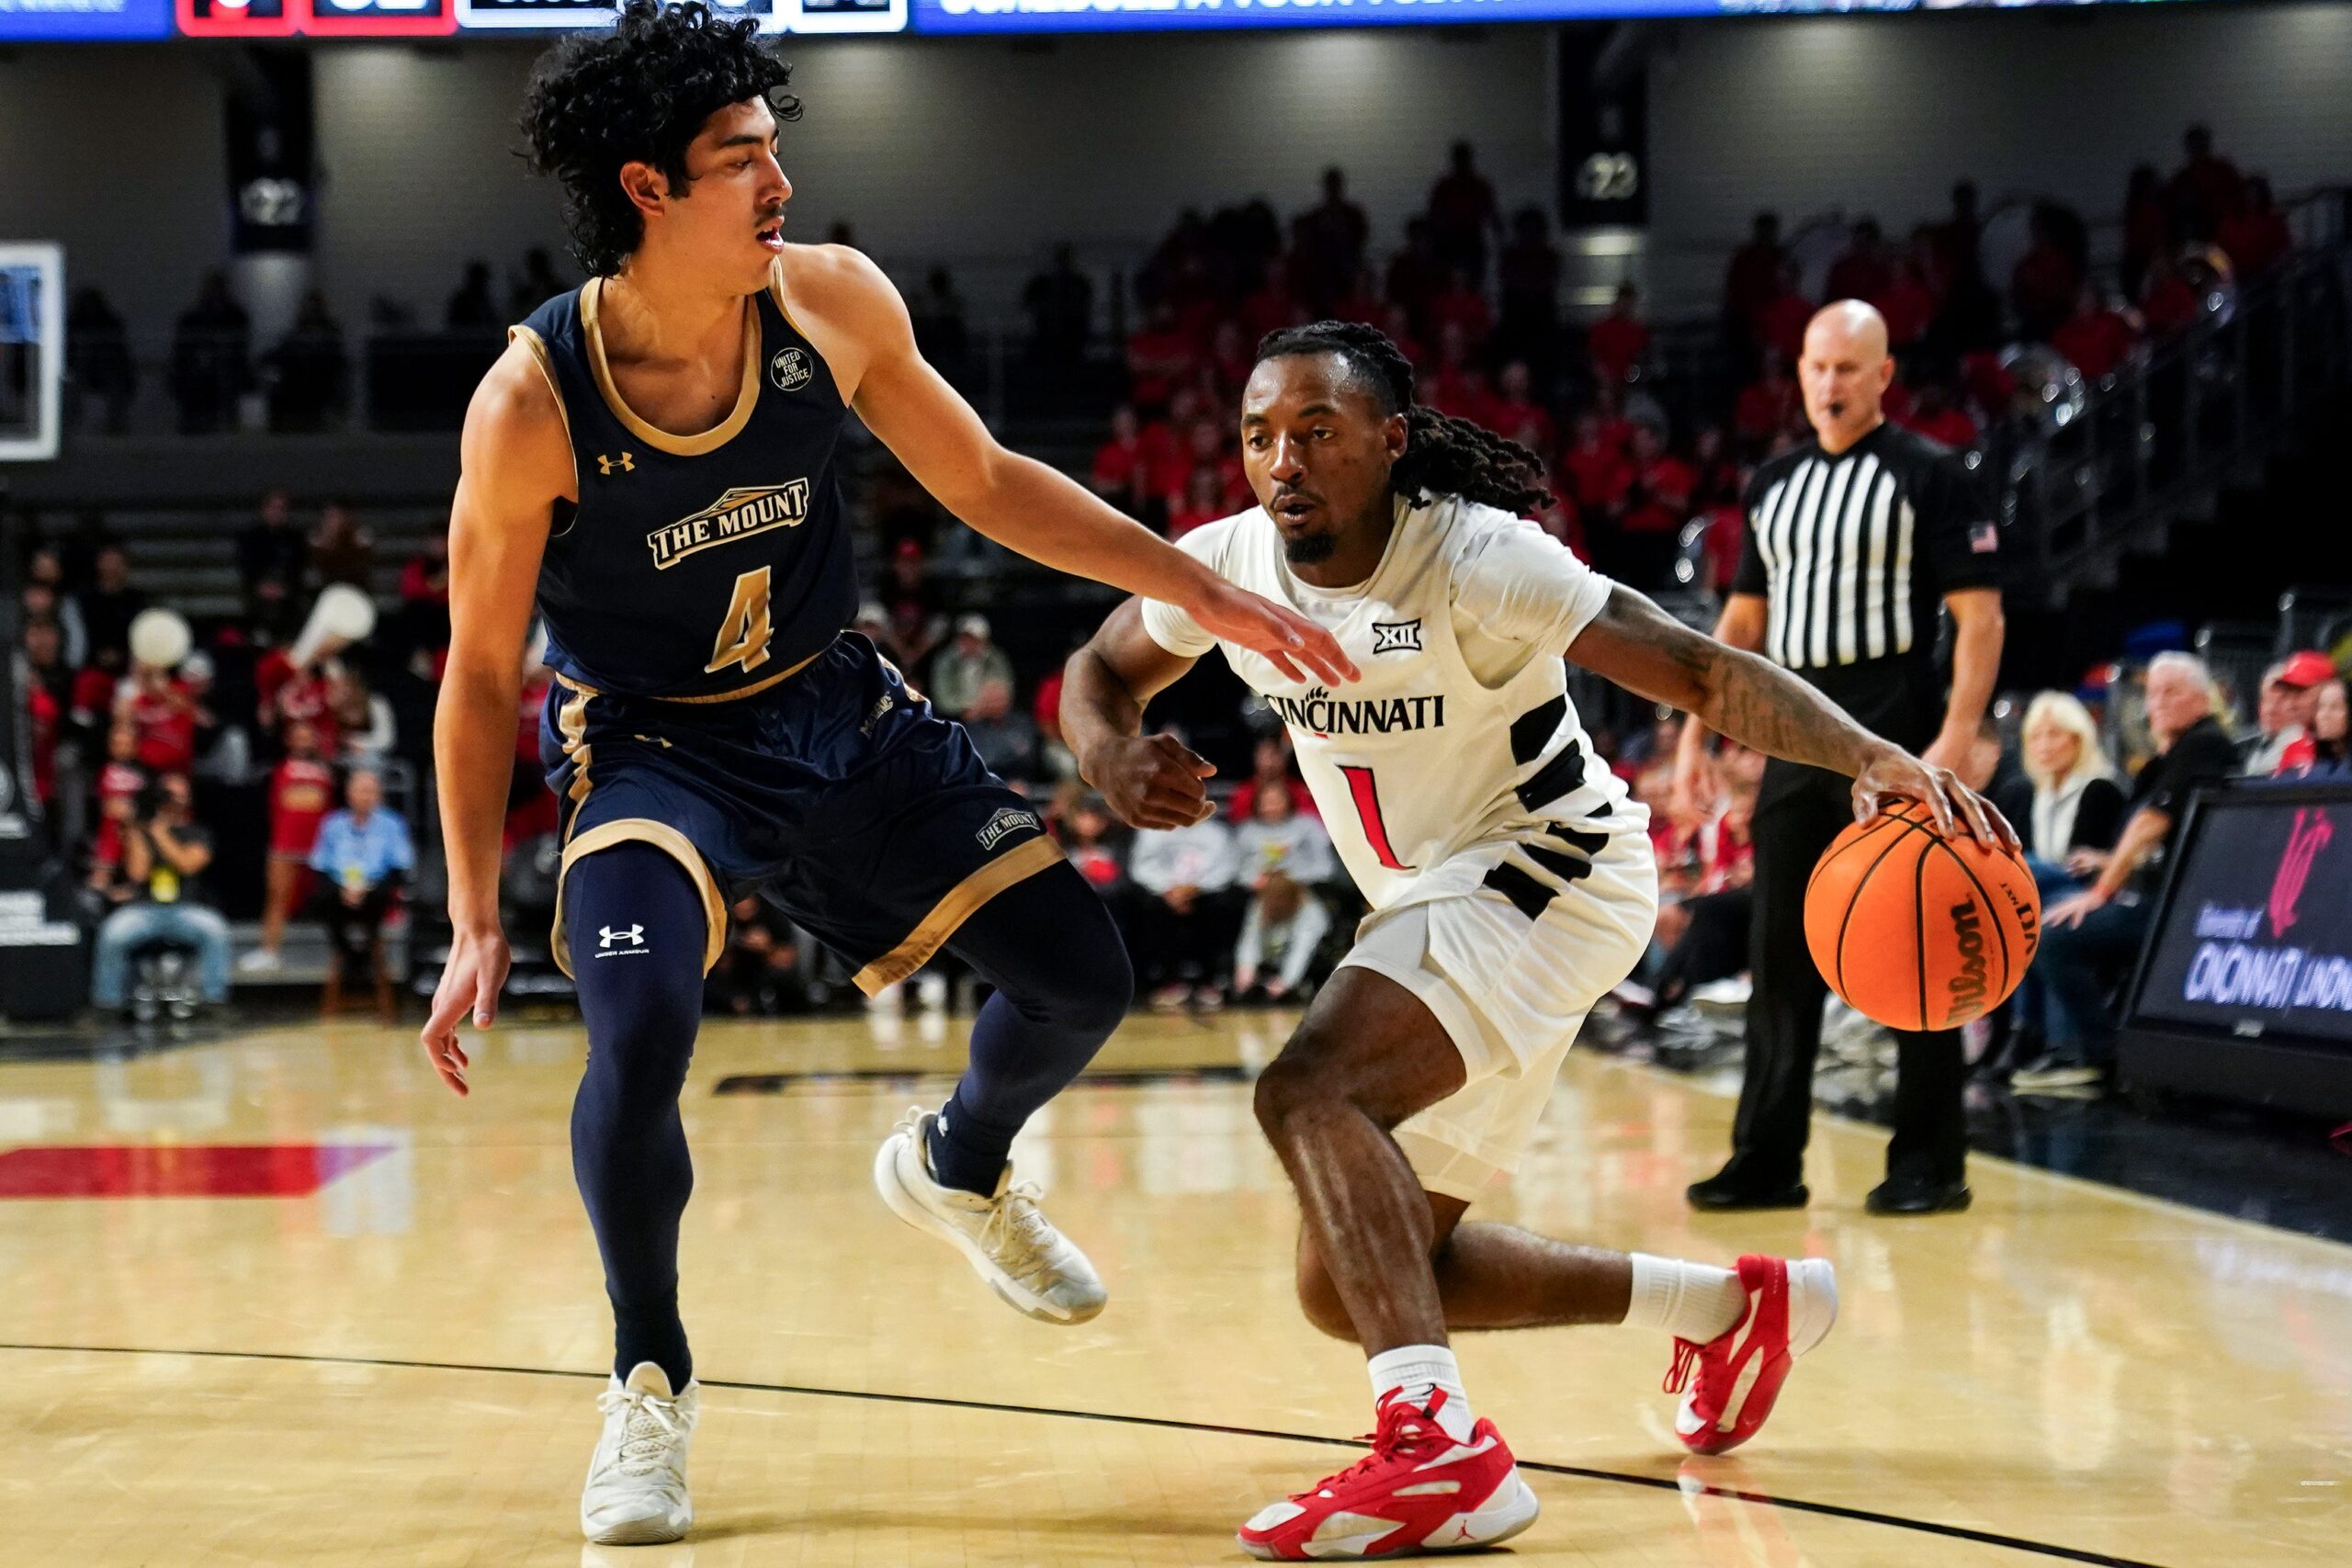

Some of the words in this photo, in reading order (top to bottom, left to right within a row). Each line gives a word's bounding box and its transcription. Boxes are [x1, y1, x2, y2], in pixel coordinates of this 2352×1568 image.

[775, 351, 801, 369] UNITED
[780, 367, 809, 388] JUSTICE
[783, 362, 798, 376] FOR
[654, 519, 711, 559] THE
[717, 483, 804, 537] MOUNT
[704, 565, 775, 673] 4
[978, 821, 1002, 845] THE
[1000, 813, 1038, 830] MOUNT
[1335, 764, 1417, 870] 1
[2016, 903, 2037, 961] VO
[1943, 898, 1987, 1028] Wilson
